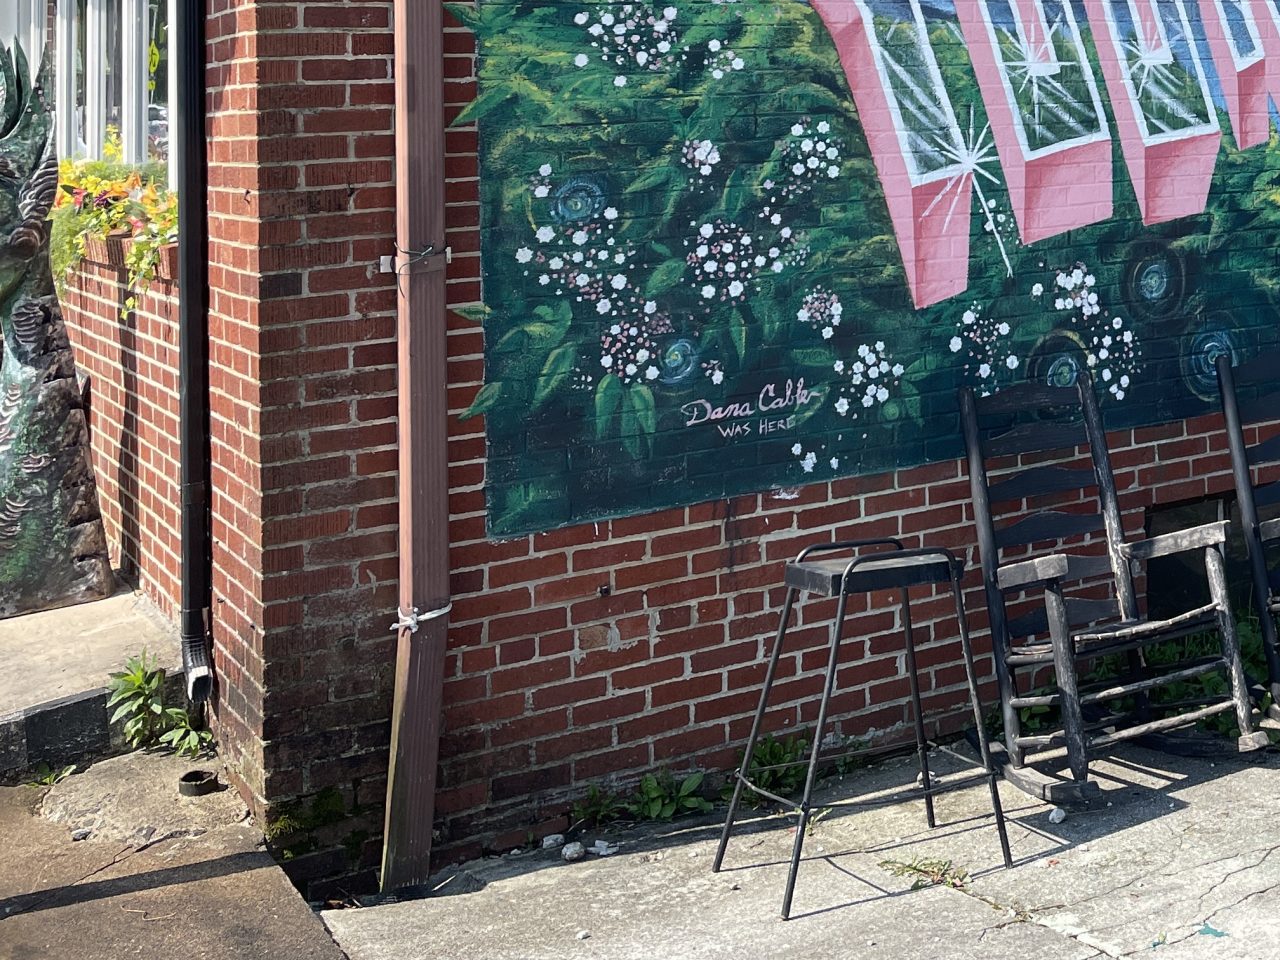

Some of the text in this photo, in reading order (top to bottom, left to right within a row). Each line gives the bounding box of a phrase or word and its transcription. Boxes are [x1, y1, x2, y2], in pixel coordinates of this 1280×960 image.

[680, 398, 756, 427] Dana
[717, 414, 796, 438] WAS HERE
